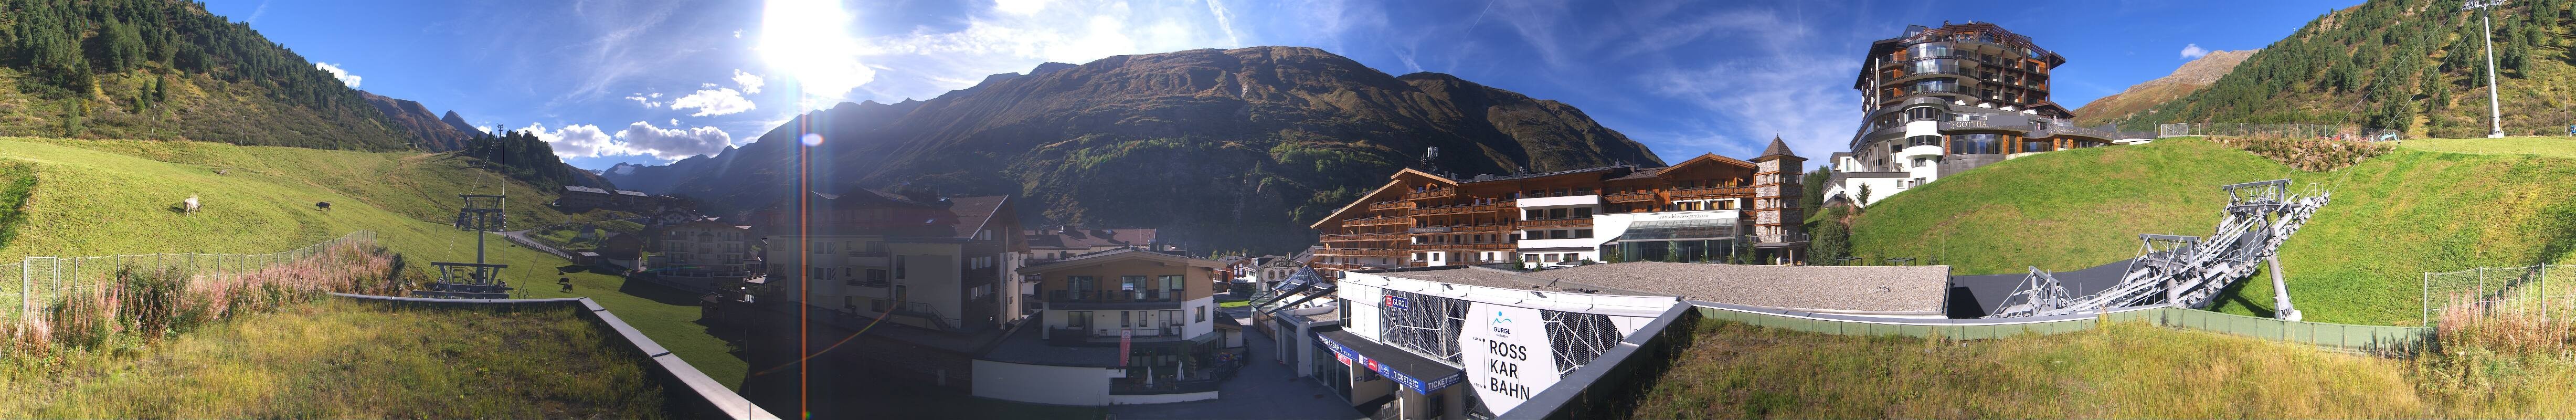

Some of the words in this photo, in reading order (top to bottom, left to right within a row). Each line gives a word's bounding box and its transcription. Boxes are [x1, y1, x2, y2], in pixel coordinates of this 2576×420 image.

[1393, 299, 1407, 308] GURGL
[1490, 340, 1526, 361] ROSS
[1490, 359, 1518, 379] KAR
[1393, 371, 1409, 384] TICKET
[1427, 377, 1448, 390] TICKET
[1491, 377, 1530, 401] BAHN
